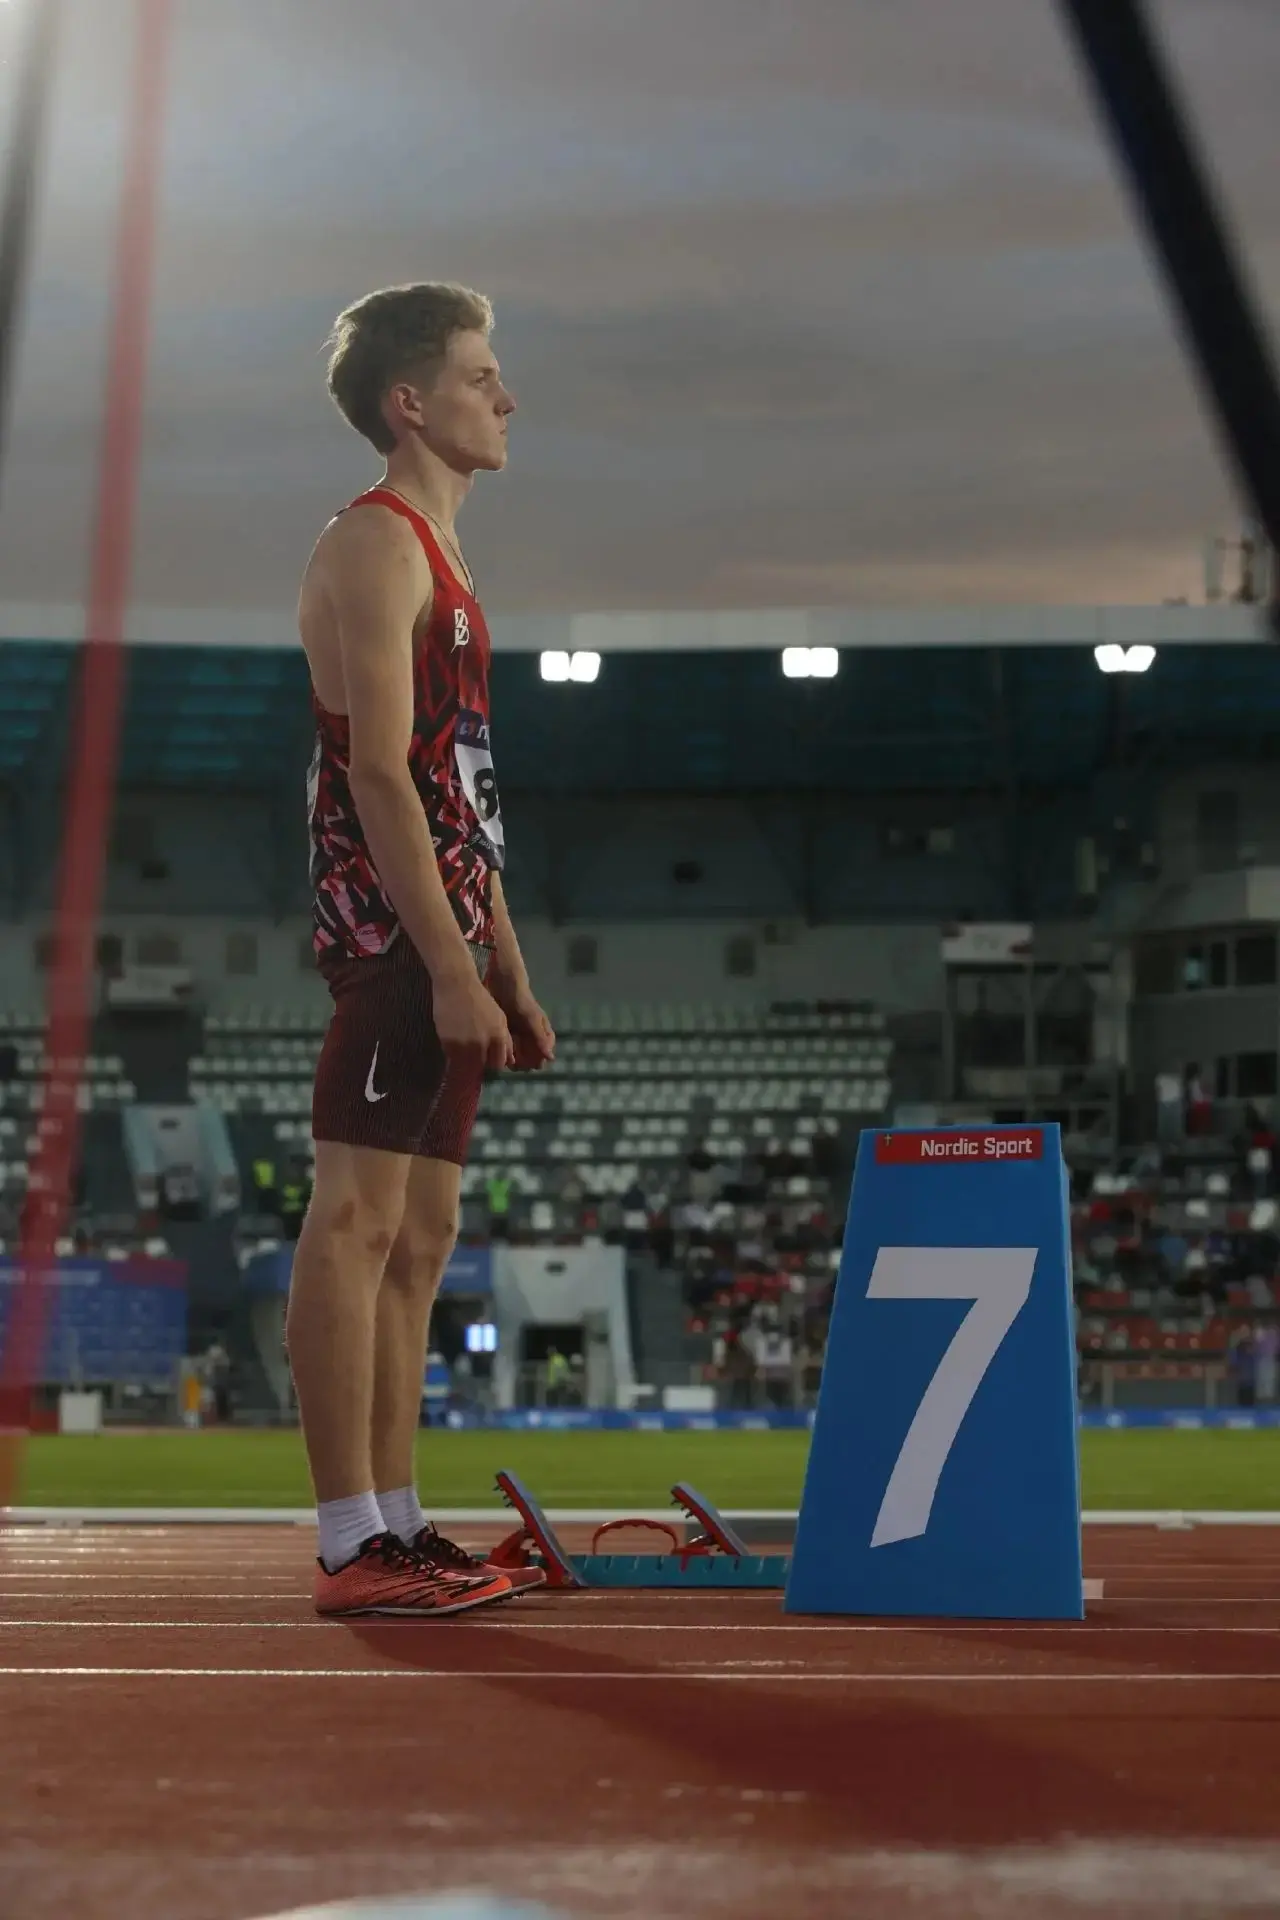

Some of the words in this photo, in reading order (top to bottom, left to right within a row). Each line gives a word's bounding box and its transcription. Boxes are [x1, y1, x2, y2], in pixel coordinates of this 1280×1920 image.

[920, 1138, 979, 1157] Nordic
[983, 1137, 1033, 1158] Sport
[865, 1246, 1040, 1548] 7
